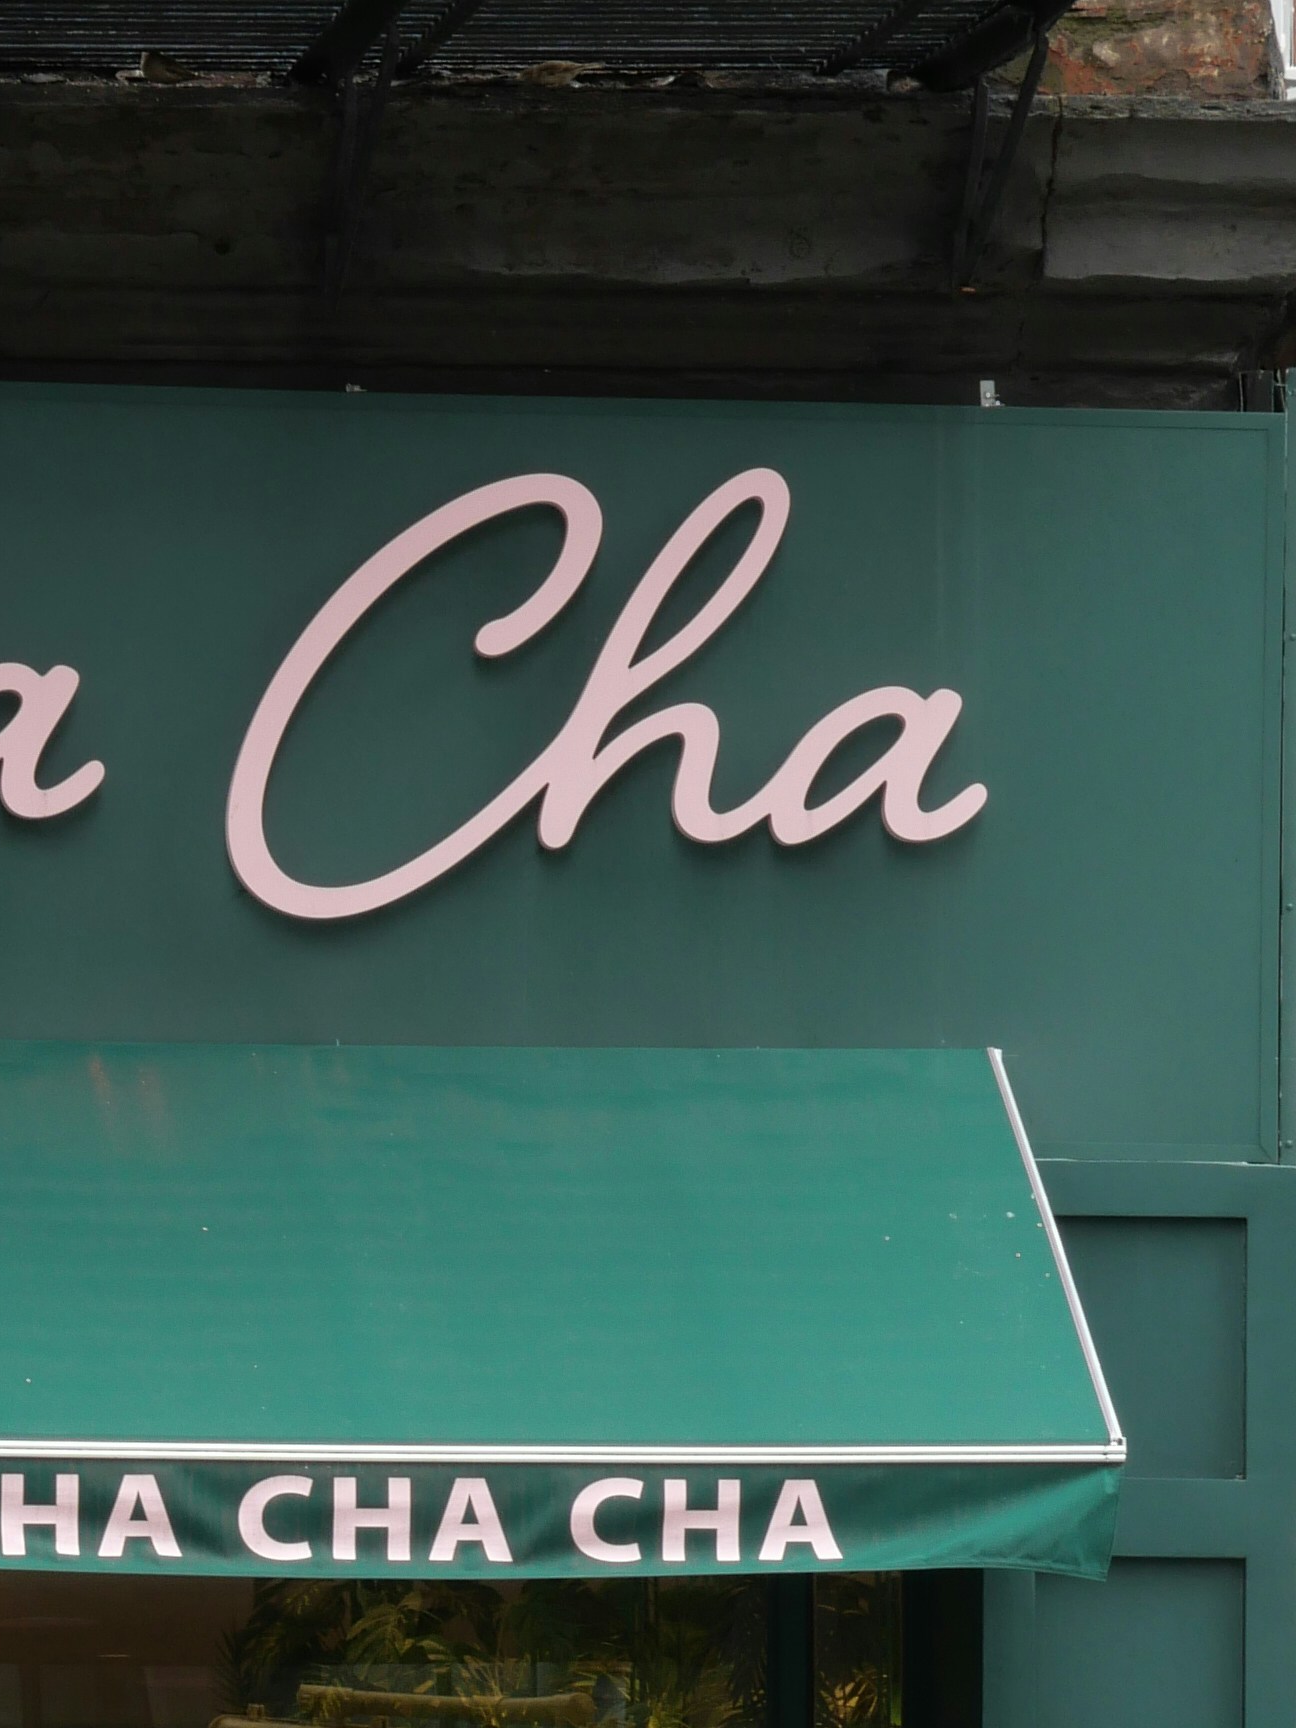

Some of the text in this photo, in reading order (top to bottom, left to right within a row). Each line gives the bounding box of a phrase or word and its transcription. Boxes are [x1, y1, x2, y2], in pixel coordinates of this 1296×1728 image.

[224, 467, 988, 920] Cha
[237, 1474, 513, 1562] CHA
[570, 1477, 842, 1562] CHA
